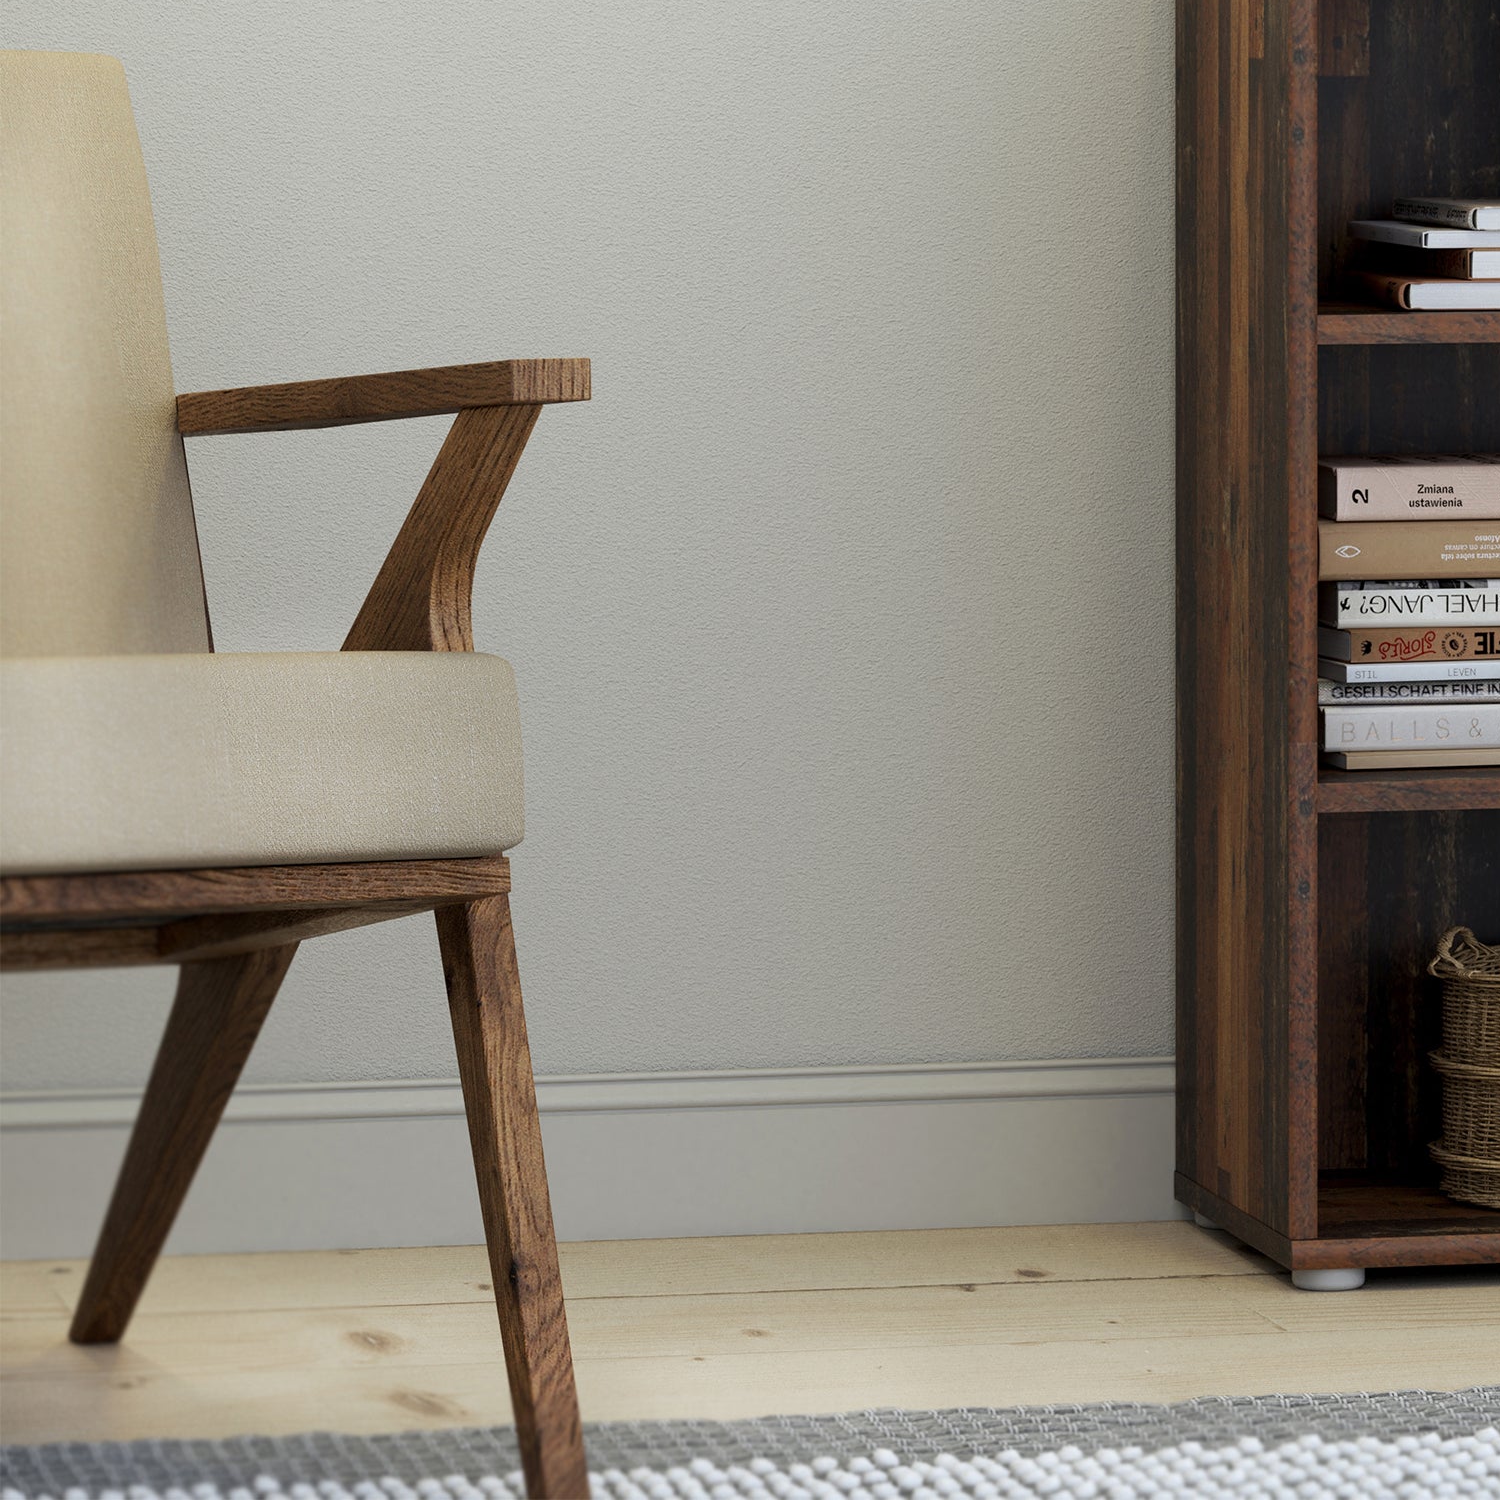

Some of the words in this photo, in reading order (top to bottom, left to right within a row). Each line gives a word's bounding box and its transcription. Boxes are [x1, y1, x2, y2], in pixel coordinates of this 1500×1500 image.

[1417, 484, 1454, 494] Zmiana
[1352, 488, 1369, 504] 2
[1409, 497, 1463, 508] ustawienia
[1441, 553, 1454, 561] tela
[1359, 595, 1434, 614] JANG?
[1379, 631, 1436, 660] STORIES
[1354, 670, 1377, 679] STIL
[1447, 668, 1477, 677] LEVEN
[1451, 683, 1483, 696] EINE
[1341, 717, 1450, 743] BALLS
[1469, 717, 1482, 738] &
